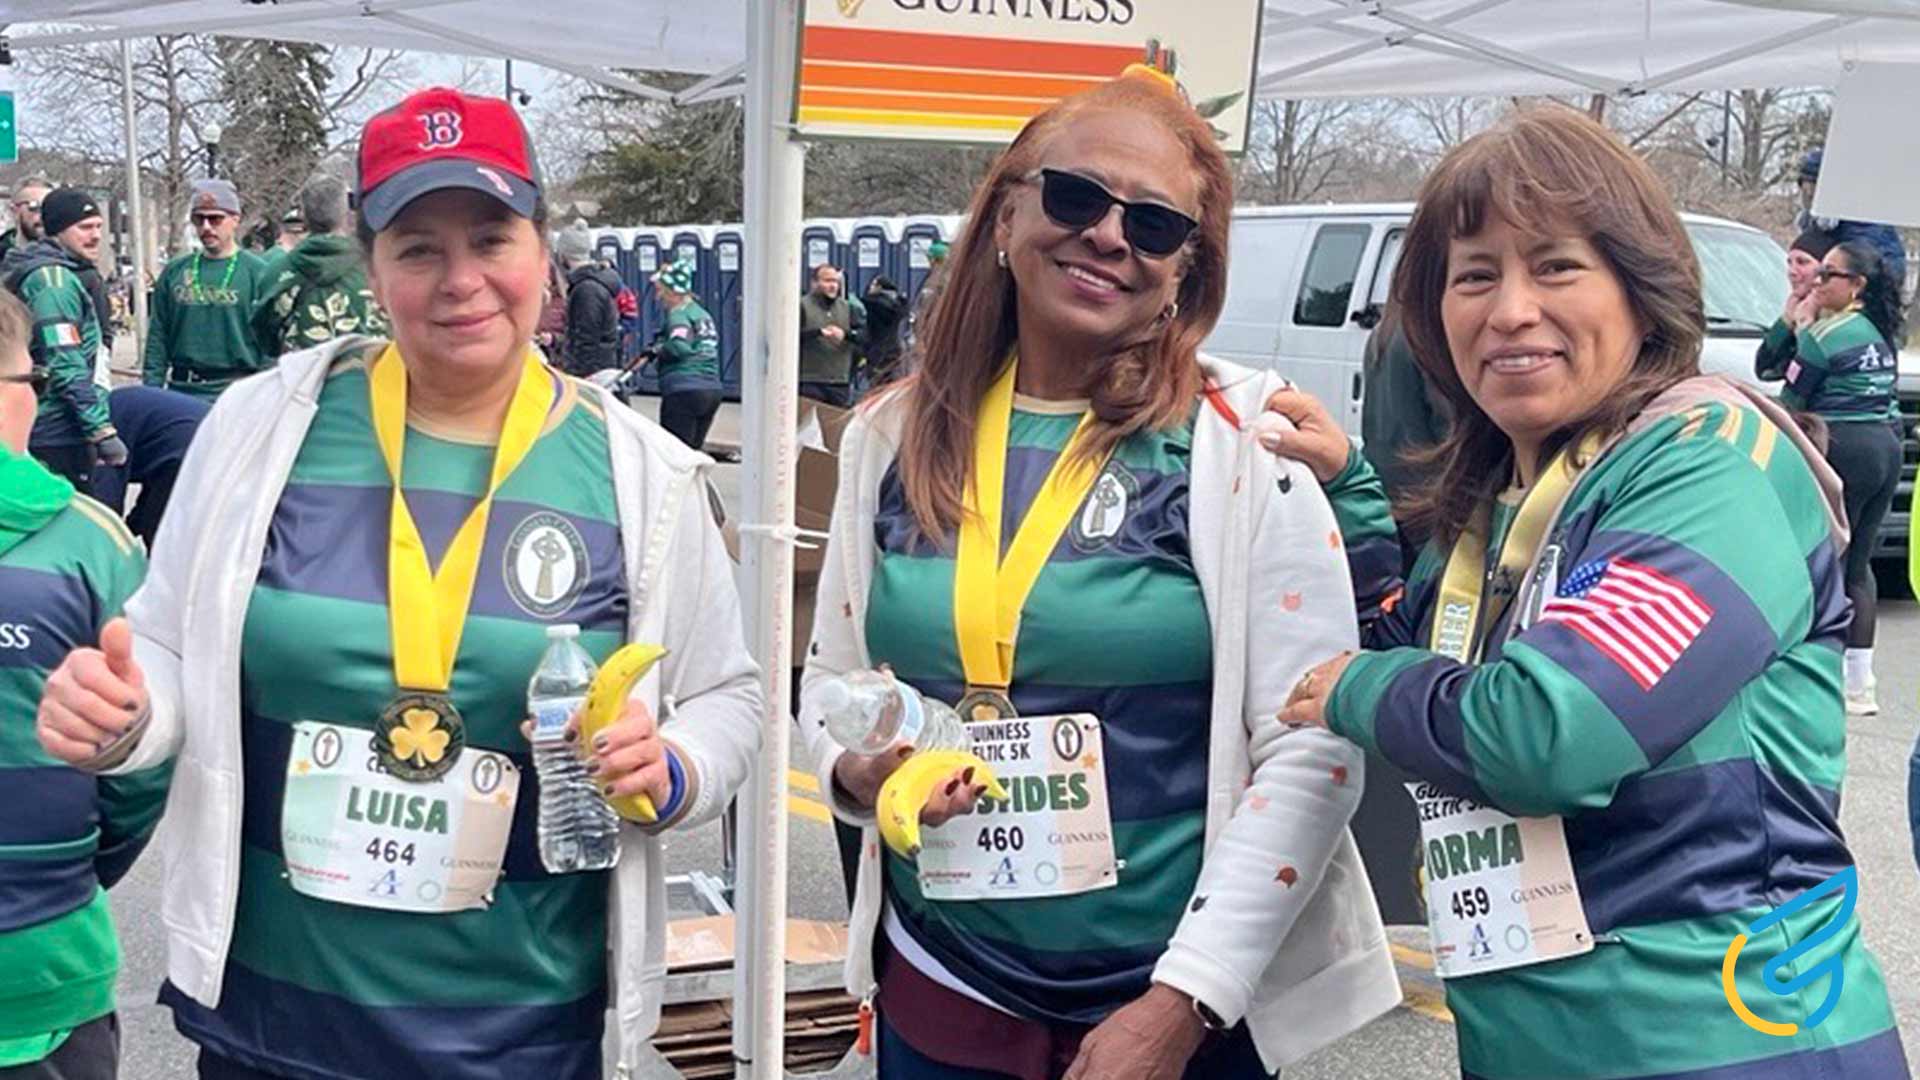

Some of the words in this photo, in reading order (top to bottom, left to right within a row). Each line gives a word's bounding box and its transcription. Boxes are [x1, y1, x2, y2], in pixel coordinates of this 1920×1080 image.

[893, 0, 1134, 25] NESS
[416, 111, 463, 151] B
[969, 722, 1030, 742] UINNESS
[971, 743, 1005, 762] ELTIC
[1010, 742, 1031, 761] 5K
[345, 786, 449, 835] LUISA
[1420, 798, 1464, 822] ELTIC
[365, 837, 416, 867] 464
[976, 825, 1024, 853] 460
[1047, 830, 1110, 847] GUINNESS
[1451, 885, 1491, 920] 459
[1510, 882, 1574, 905] GUINNESS
